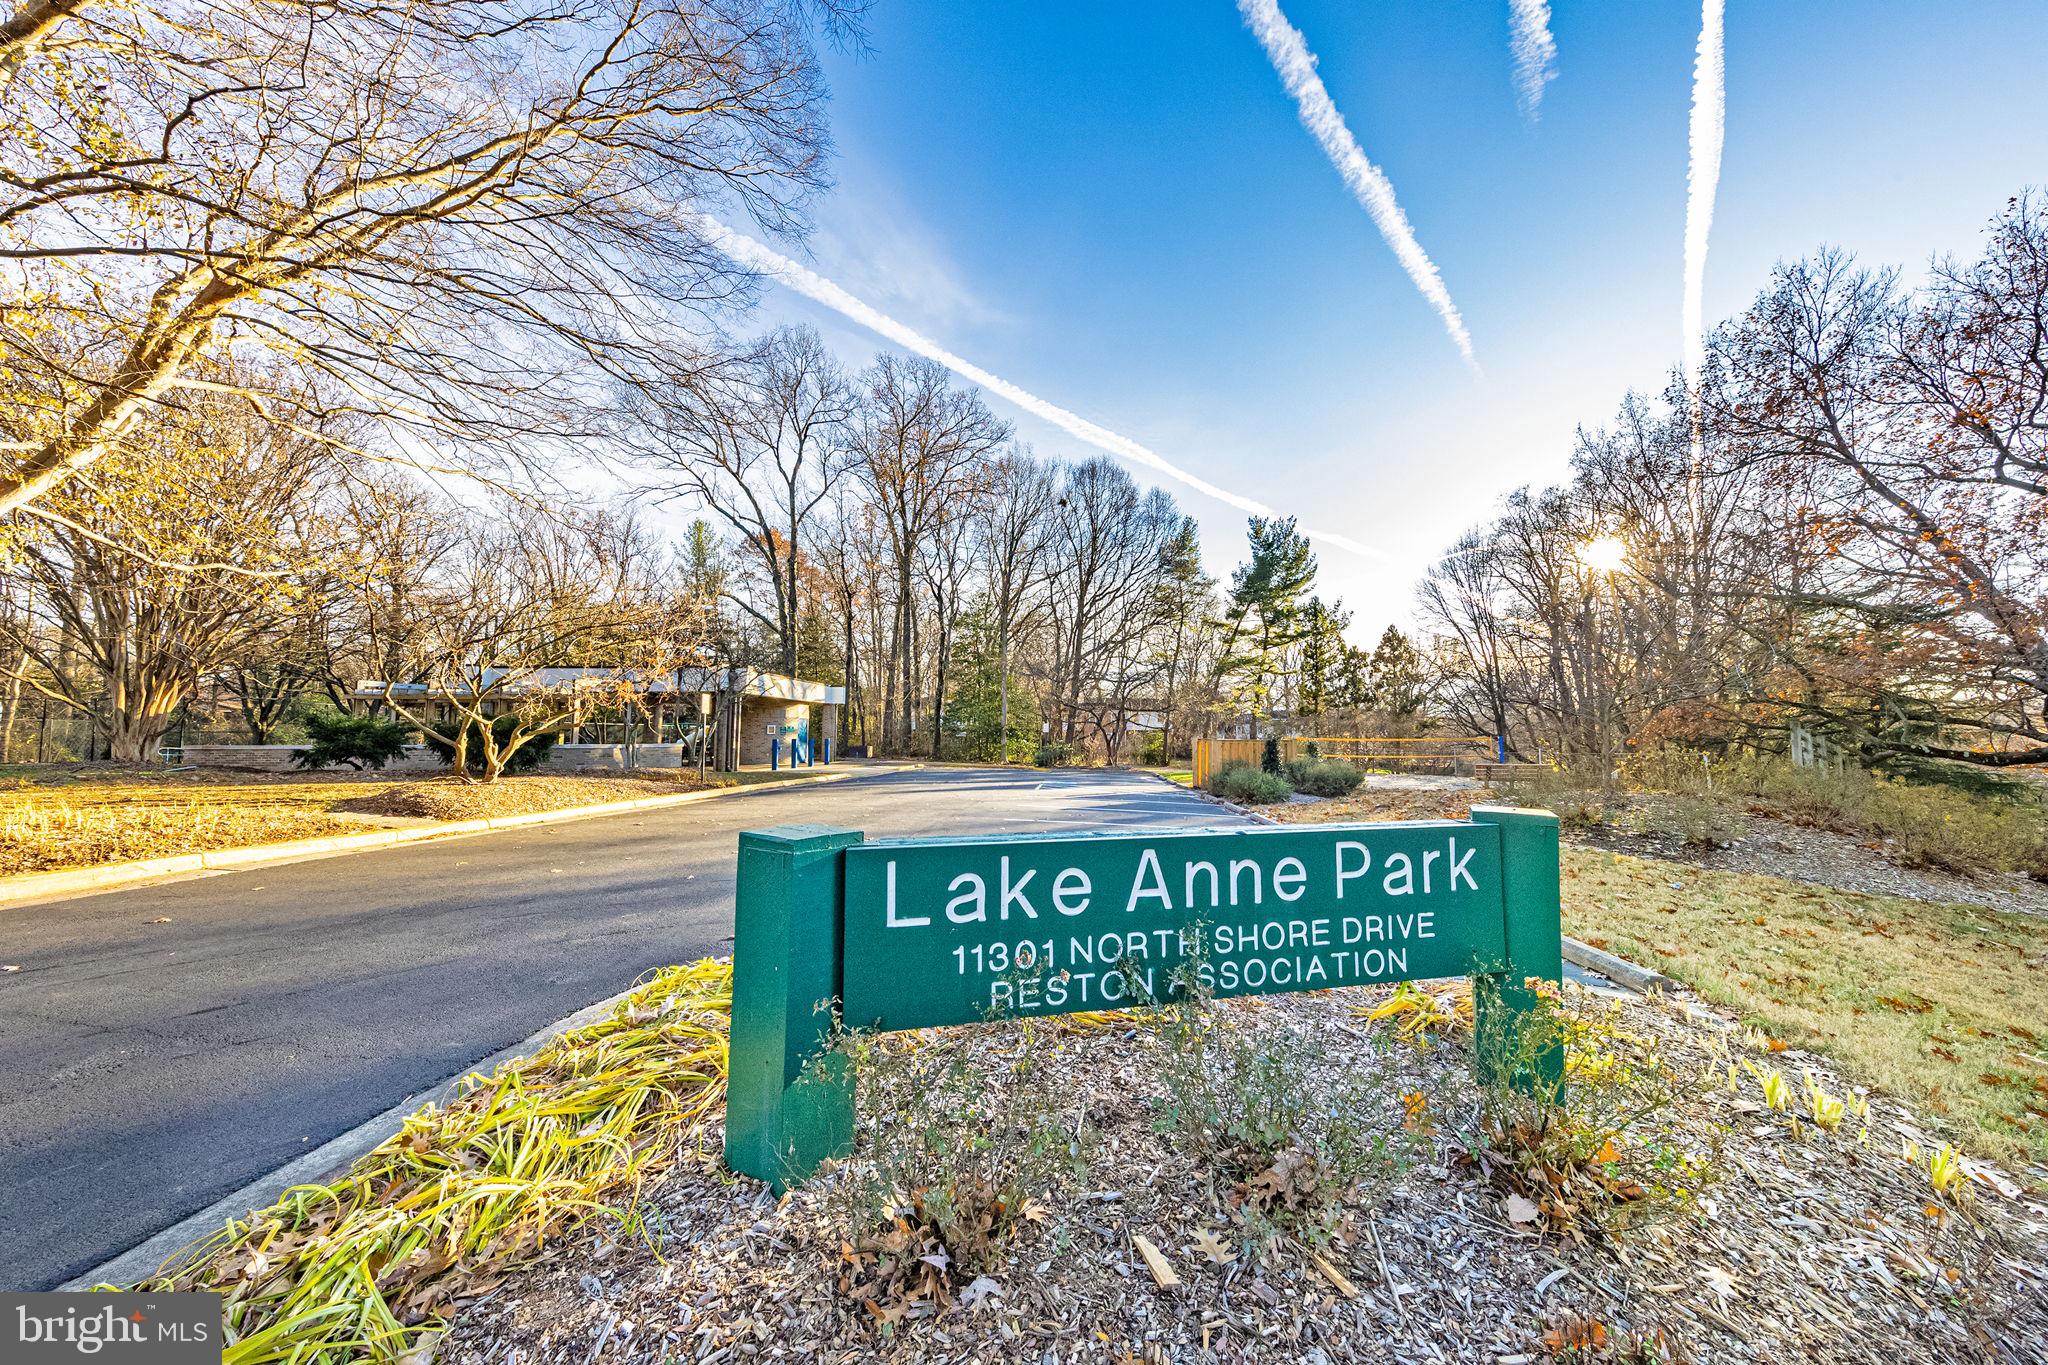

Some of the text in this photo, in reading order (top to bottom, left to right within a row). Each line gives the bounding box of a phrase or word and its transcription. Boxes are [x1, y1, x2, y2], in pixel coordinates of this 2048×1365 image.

[886, 836, 1480, 928] Lake Anne Park
[952, 911, 1437, 975] 11301 NORTH SHORE DRIVE
